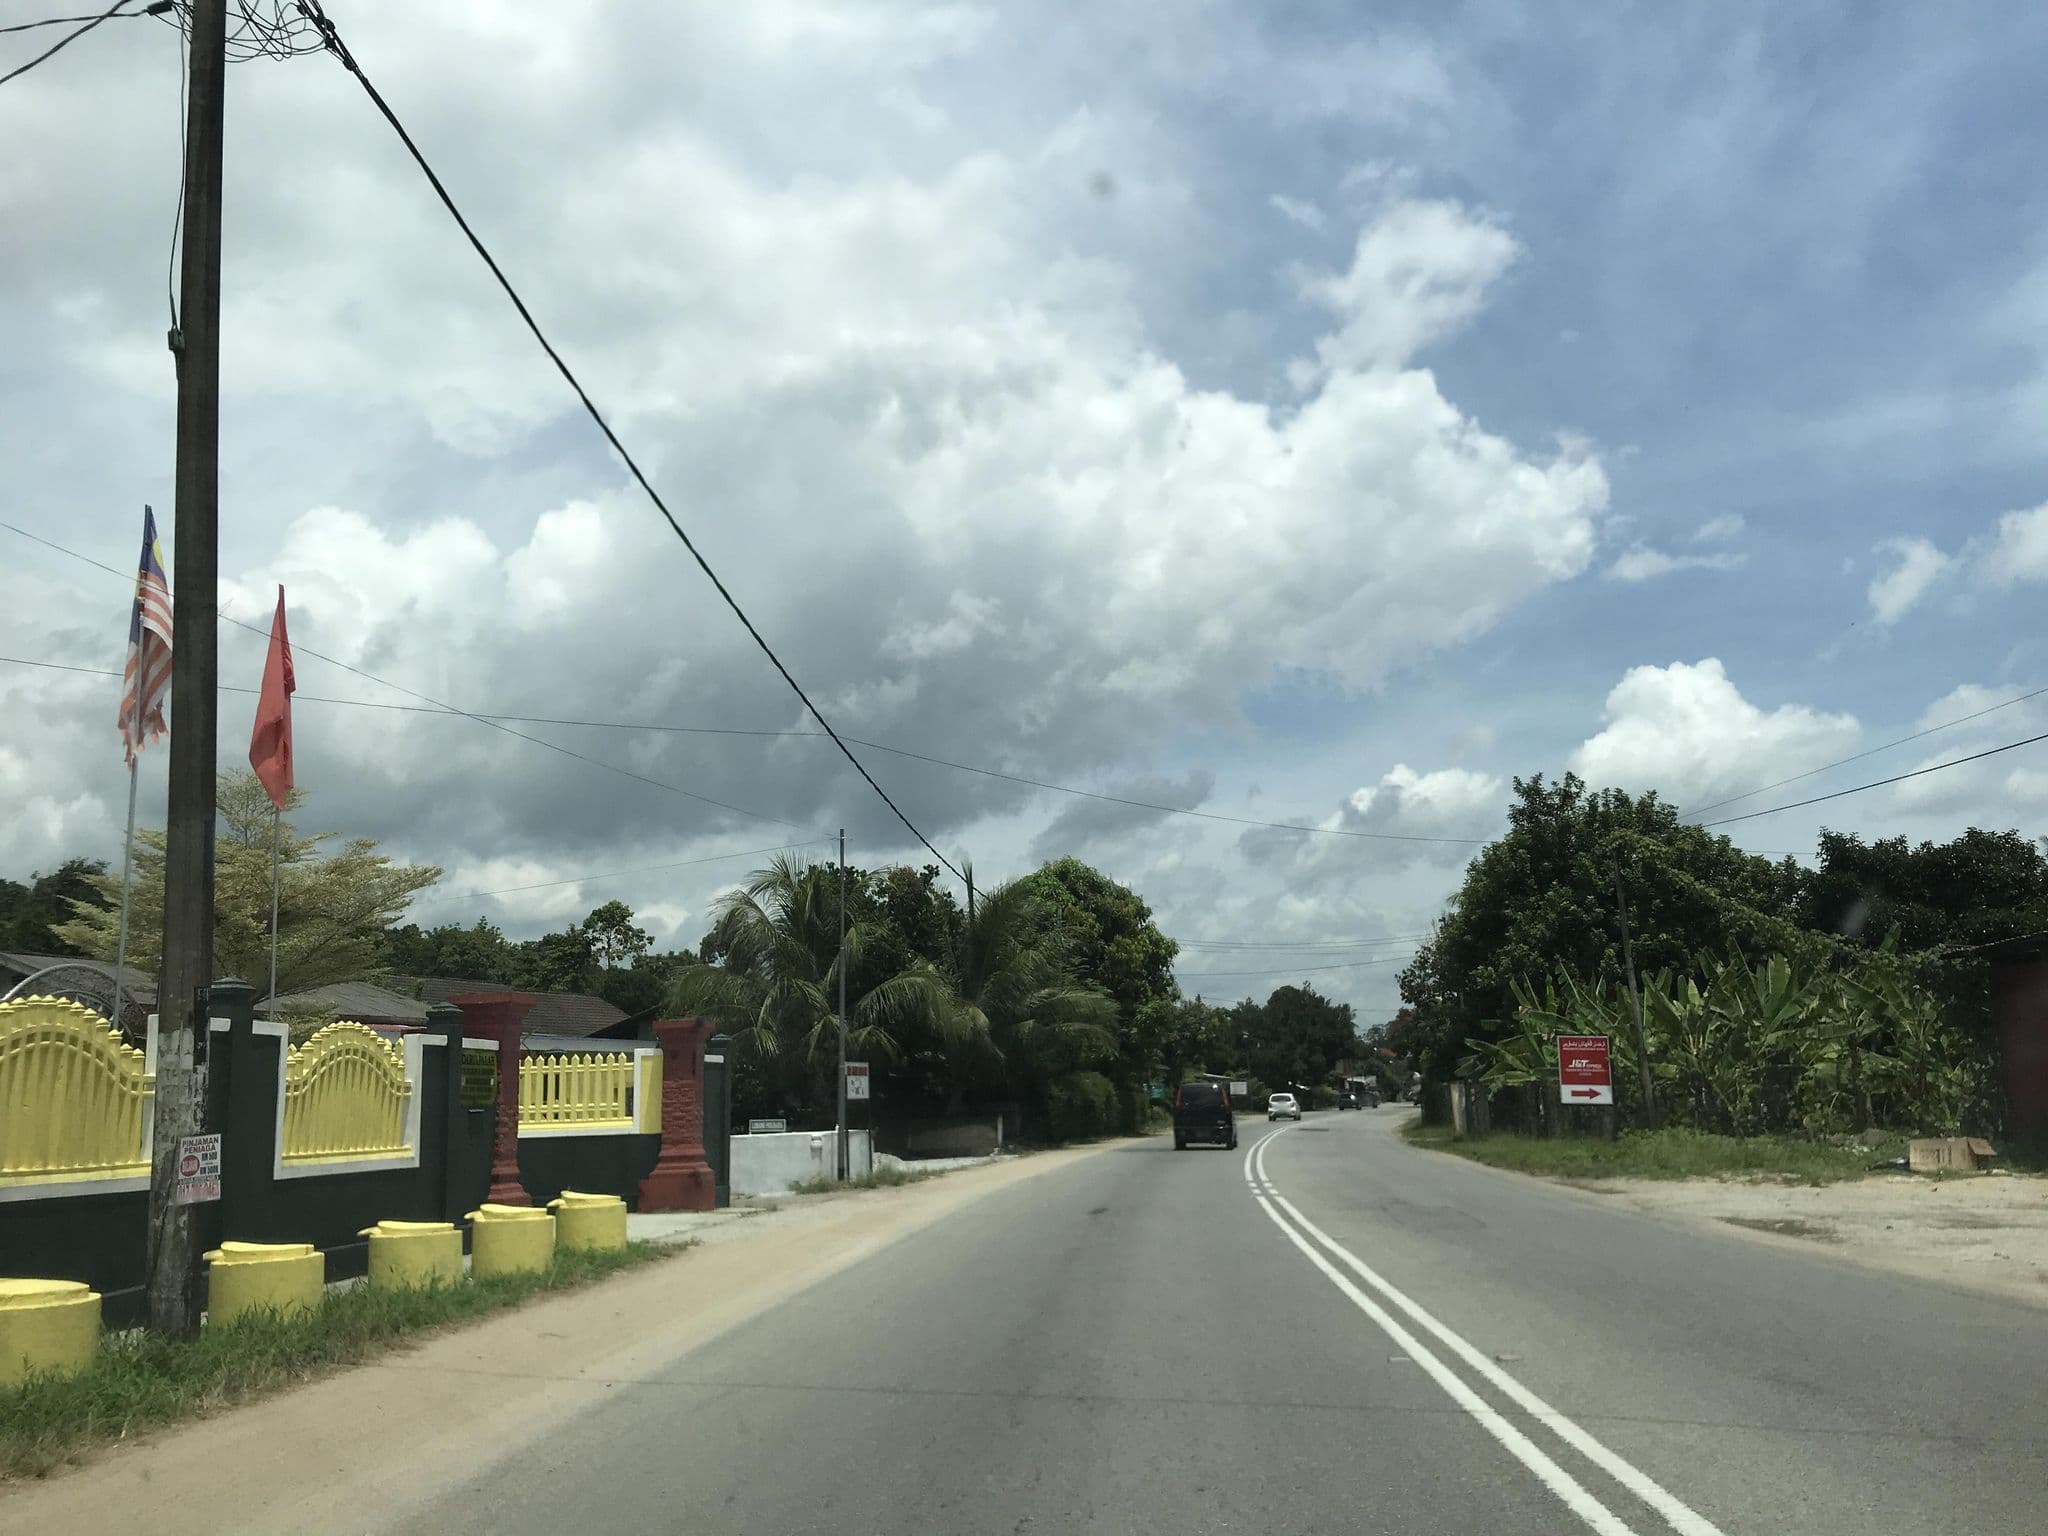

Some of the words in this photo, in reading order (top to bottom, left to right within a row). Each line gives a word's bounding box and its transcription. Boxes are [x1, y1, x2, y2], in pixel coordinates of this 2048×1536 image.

[1568, 1059, 1590, 1068] J&T
[182, 1136, 219, 1147] PINJAMAN
[184, 1144, 216, 1153] PENIAGA
